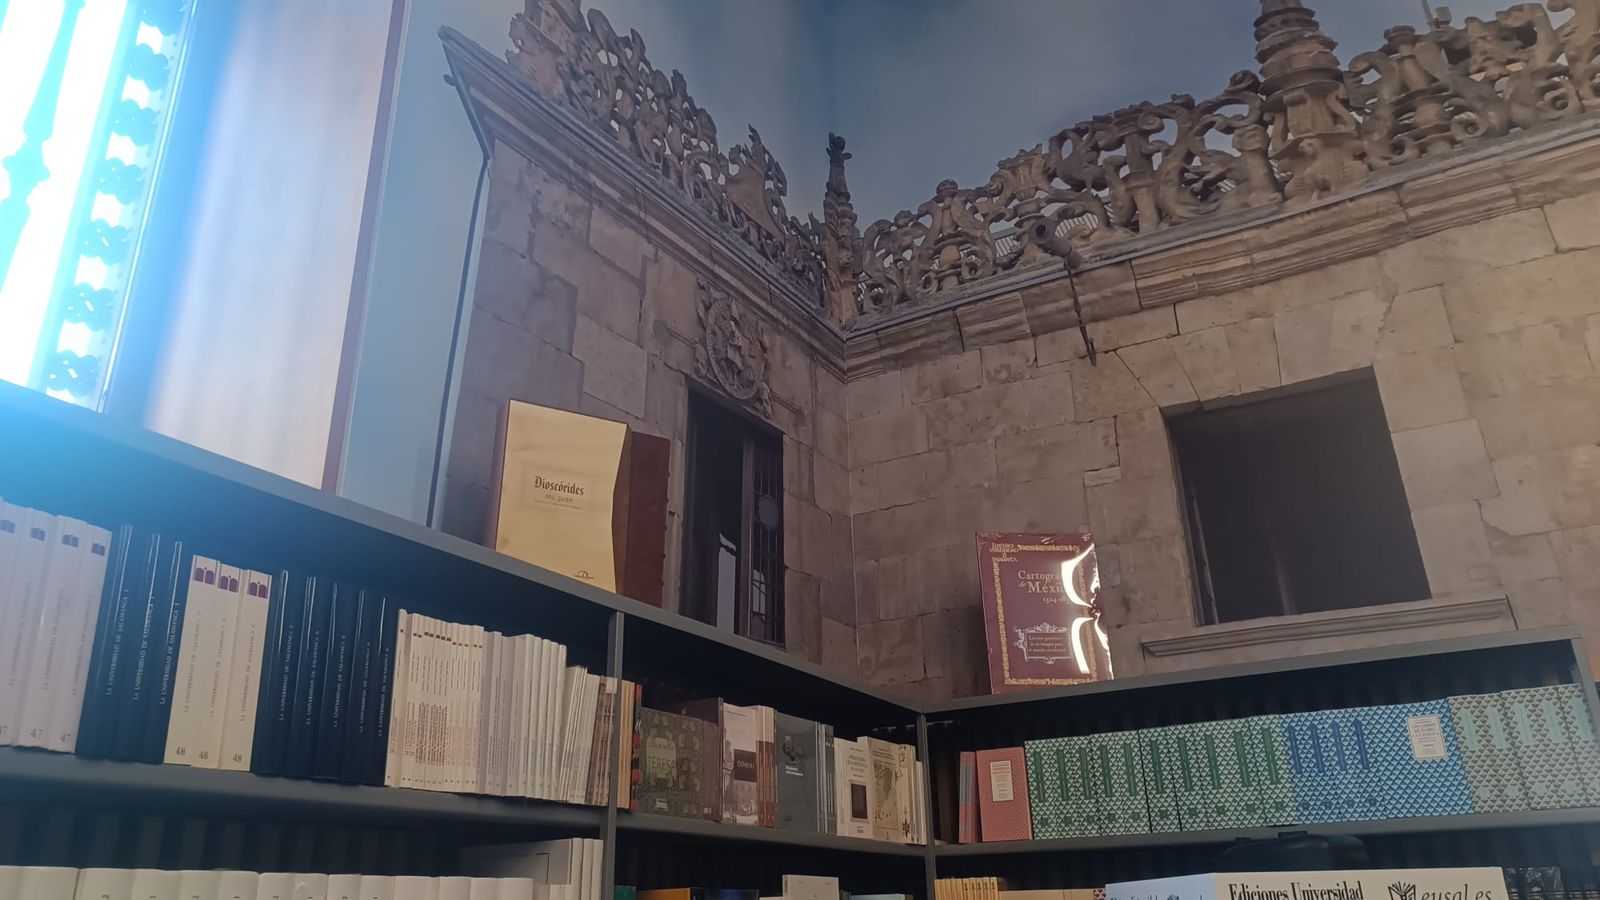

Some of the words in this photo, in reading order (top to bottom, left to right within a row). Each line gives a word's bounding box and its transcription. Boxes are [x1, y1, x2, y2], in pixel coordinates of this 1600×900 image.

[534, 475, 585, 495] Dioscórides
[1017, 569, 1062, 583] Cartogra
[1027, 581, 1065, 593] Méxi
[174, 746, 186, 757] 48
[199, 750, 209, 760] 48
[232, 753, 243, 763] 48
[1228, 883, 1290, 900] Ediciones
[1290, 880, 1364, 900] Universidad
[1420, 883, 1492, 900] eusales
